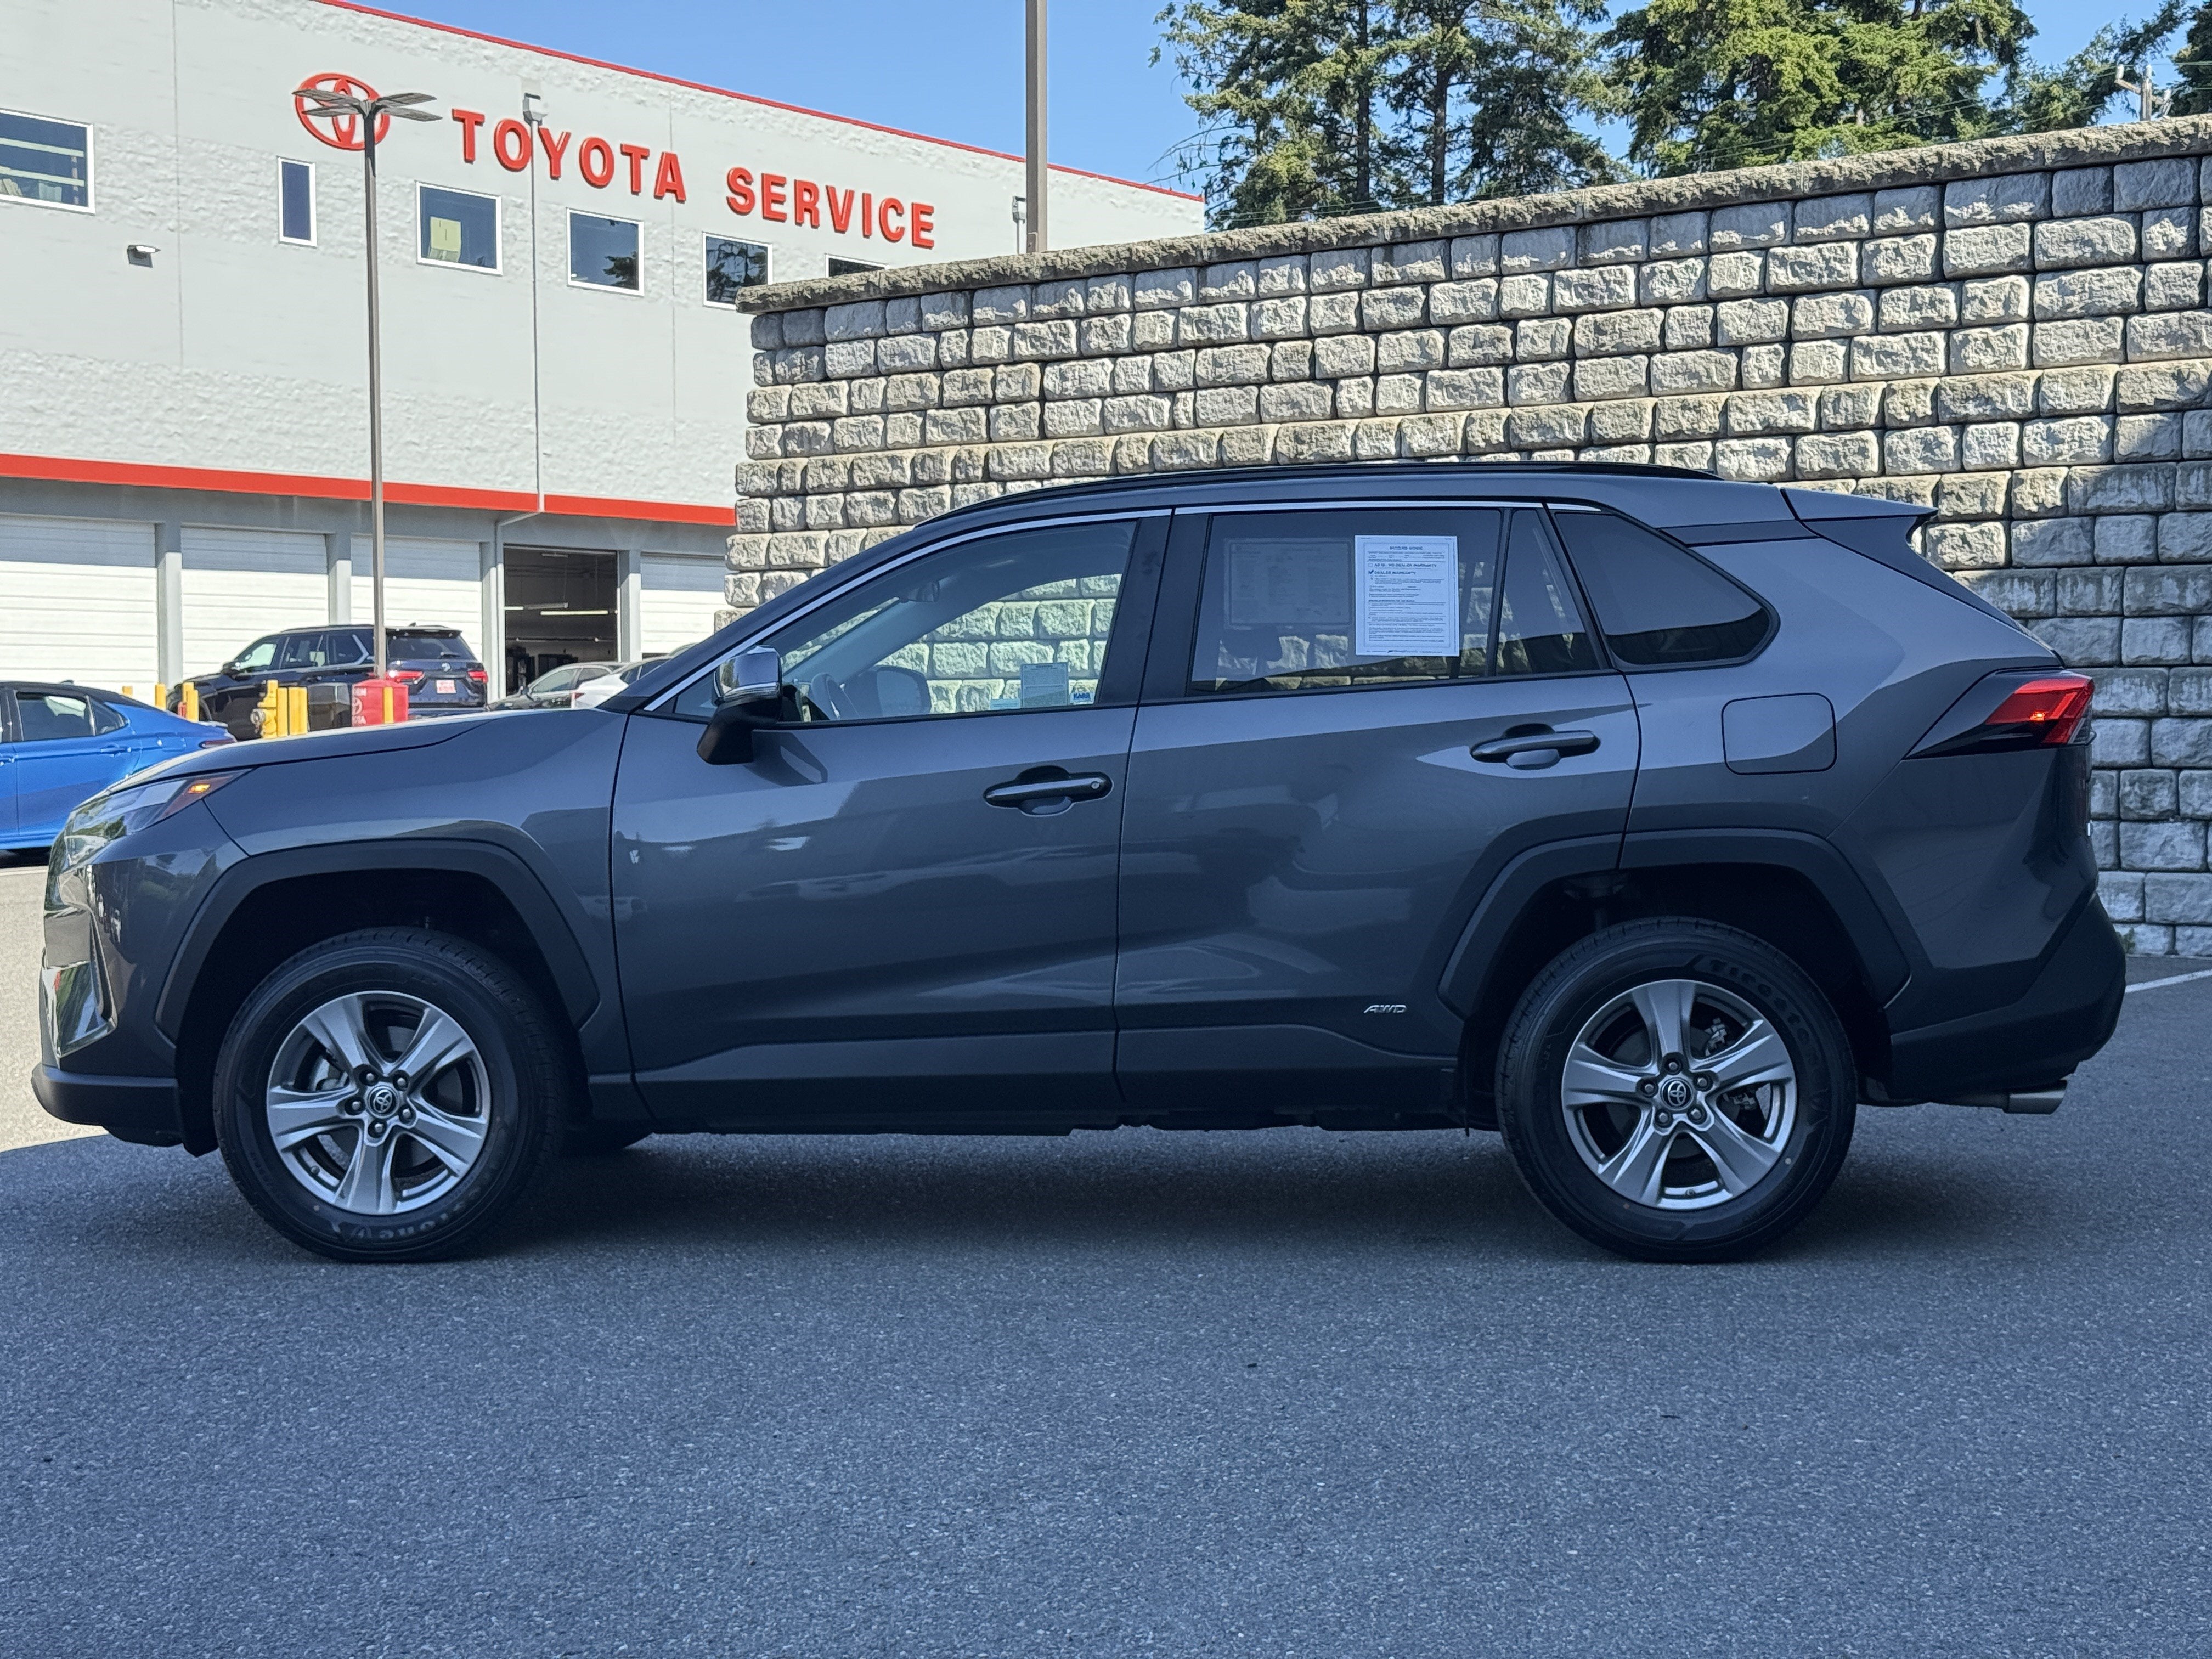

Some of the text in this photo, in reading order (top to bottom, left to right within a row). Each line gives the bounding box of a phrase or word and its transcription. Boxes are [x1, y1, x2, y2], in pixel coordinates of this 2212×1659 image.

[452, 108, 934, 249] TOYOTA SERVICE
[1363, 1005, 1407, 1014] AWD
